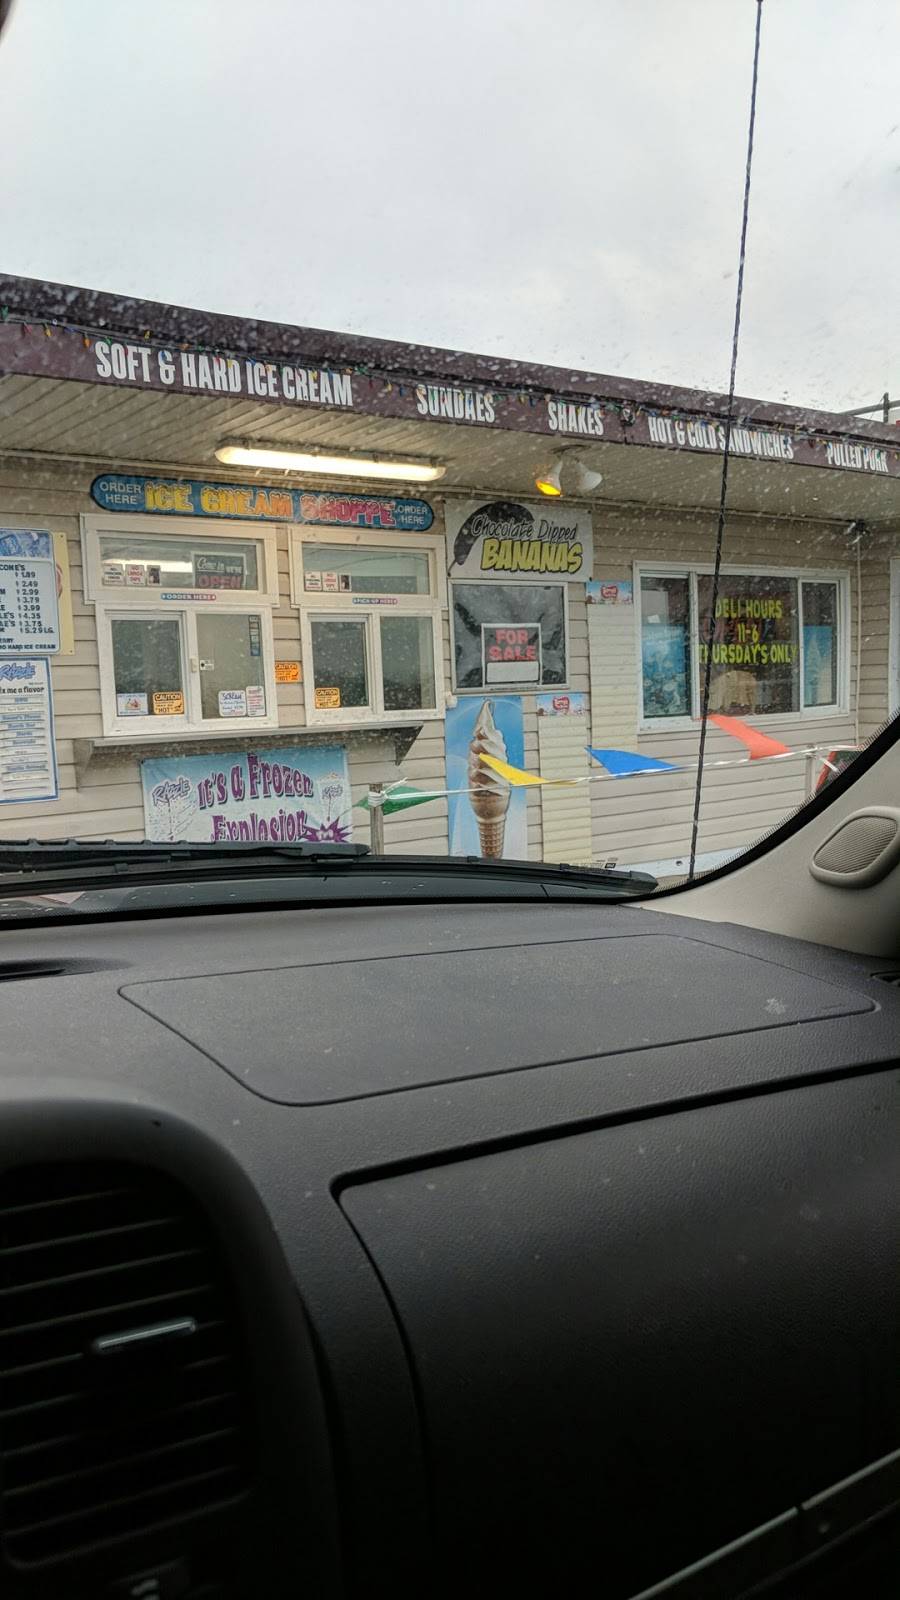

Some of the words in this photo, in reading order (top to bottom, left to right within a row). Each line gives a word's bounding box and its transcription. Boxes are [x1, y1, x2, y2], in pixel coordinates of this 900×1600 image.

[94, 341, 151, 382] SOFT
[158, 350, 176, 385] &
[180, 352, 242, 393] HARD
[245, 360, 279, 398] ICE
[282, 364, 354, 407] CREAM
[416, 384, 496, 424] SUNDAES
[548, 401, 604, 436] SHAKES
[647, 416, 674, 445] HOT
[675, 421, 686, 446] &
[687, 421, 718, 450] COLD
[718, 426, 795, 460] SANDWICHES
[826, 442, 862, 470] PULLED
[863, 447, 889, 473] PORK
[100, 481, 142, 494] ORDER
[105, 494, 138, 505] HERE
[144, 482, 195, 512] ICE
[201, 487, 293, 519] CREAM
[300, 493, 397, 527] SHOPPE
[398, 505, 428, 515] ORDER
[401, 515, 425, 525] HERE
[471, 514, 534, 537] Chocolate
[537, 519, 578, 544] Dipped
[480, 537, 583, 574] BANANAS
[198, 574, 242, 588] OPEN
[715, 598, 741, 619] DELI
[745, 598, 783, 619] HOURS
[495, 628, 528, 645] FOR
[489, 645, 537, 661] SALE
[770, 643, 798, 664] ONLY
[24, 686, 45, 694] flavor
[155, 693, 181, 701] CAUTION
[197, 772, 227, 809] It's
[230, 764, 246, 800] a
[247, 751, 313, 798] Frozen
